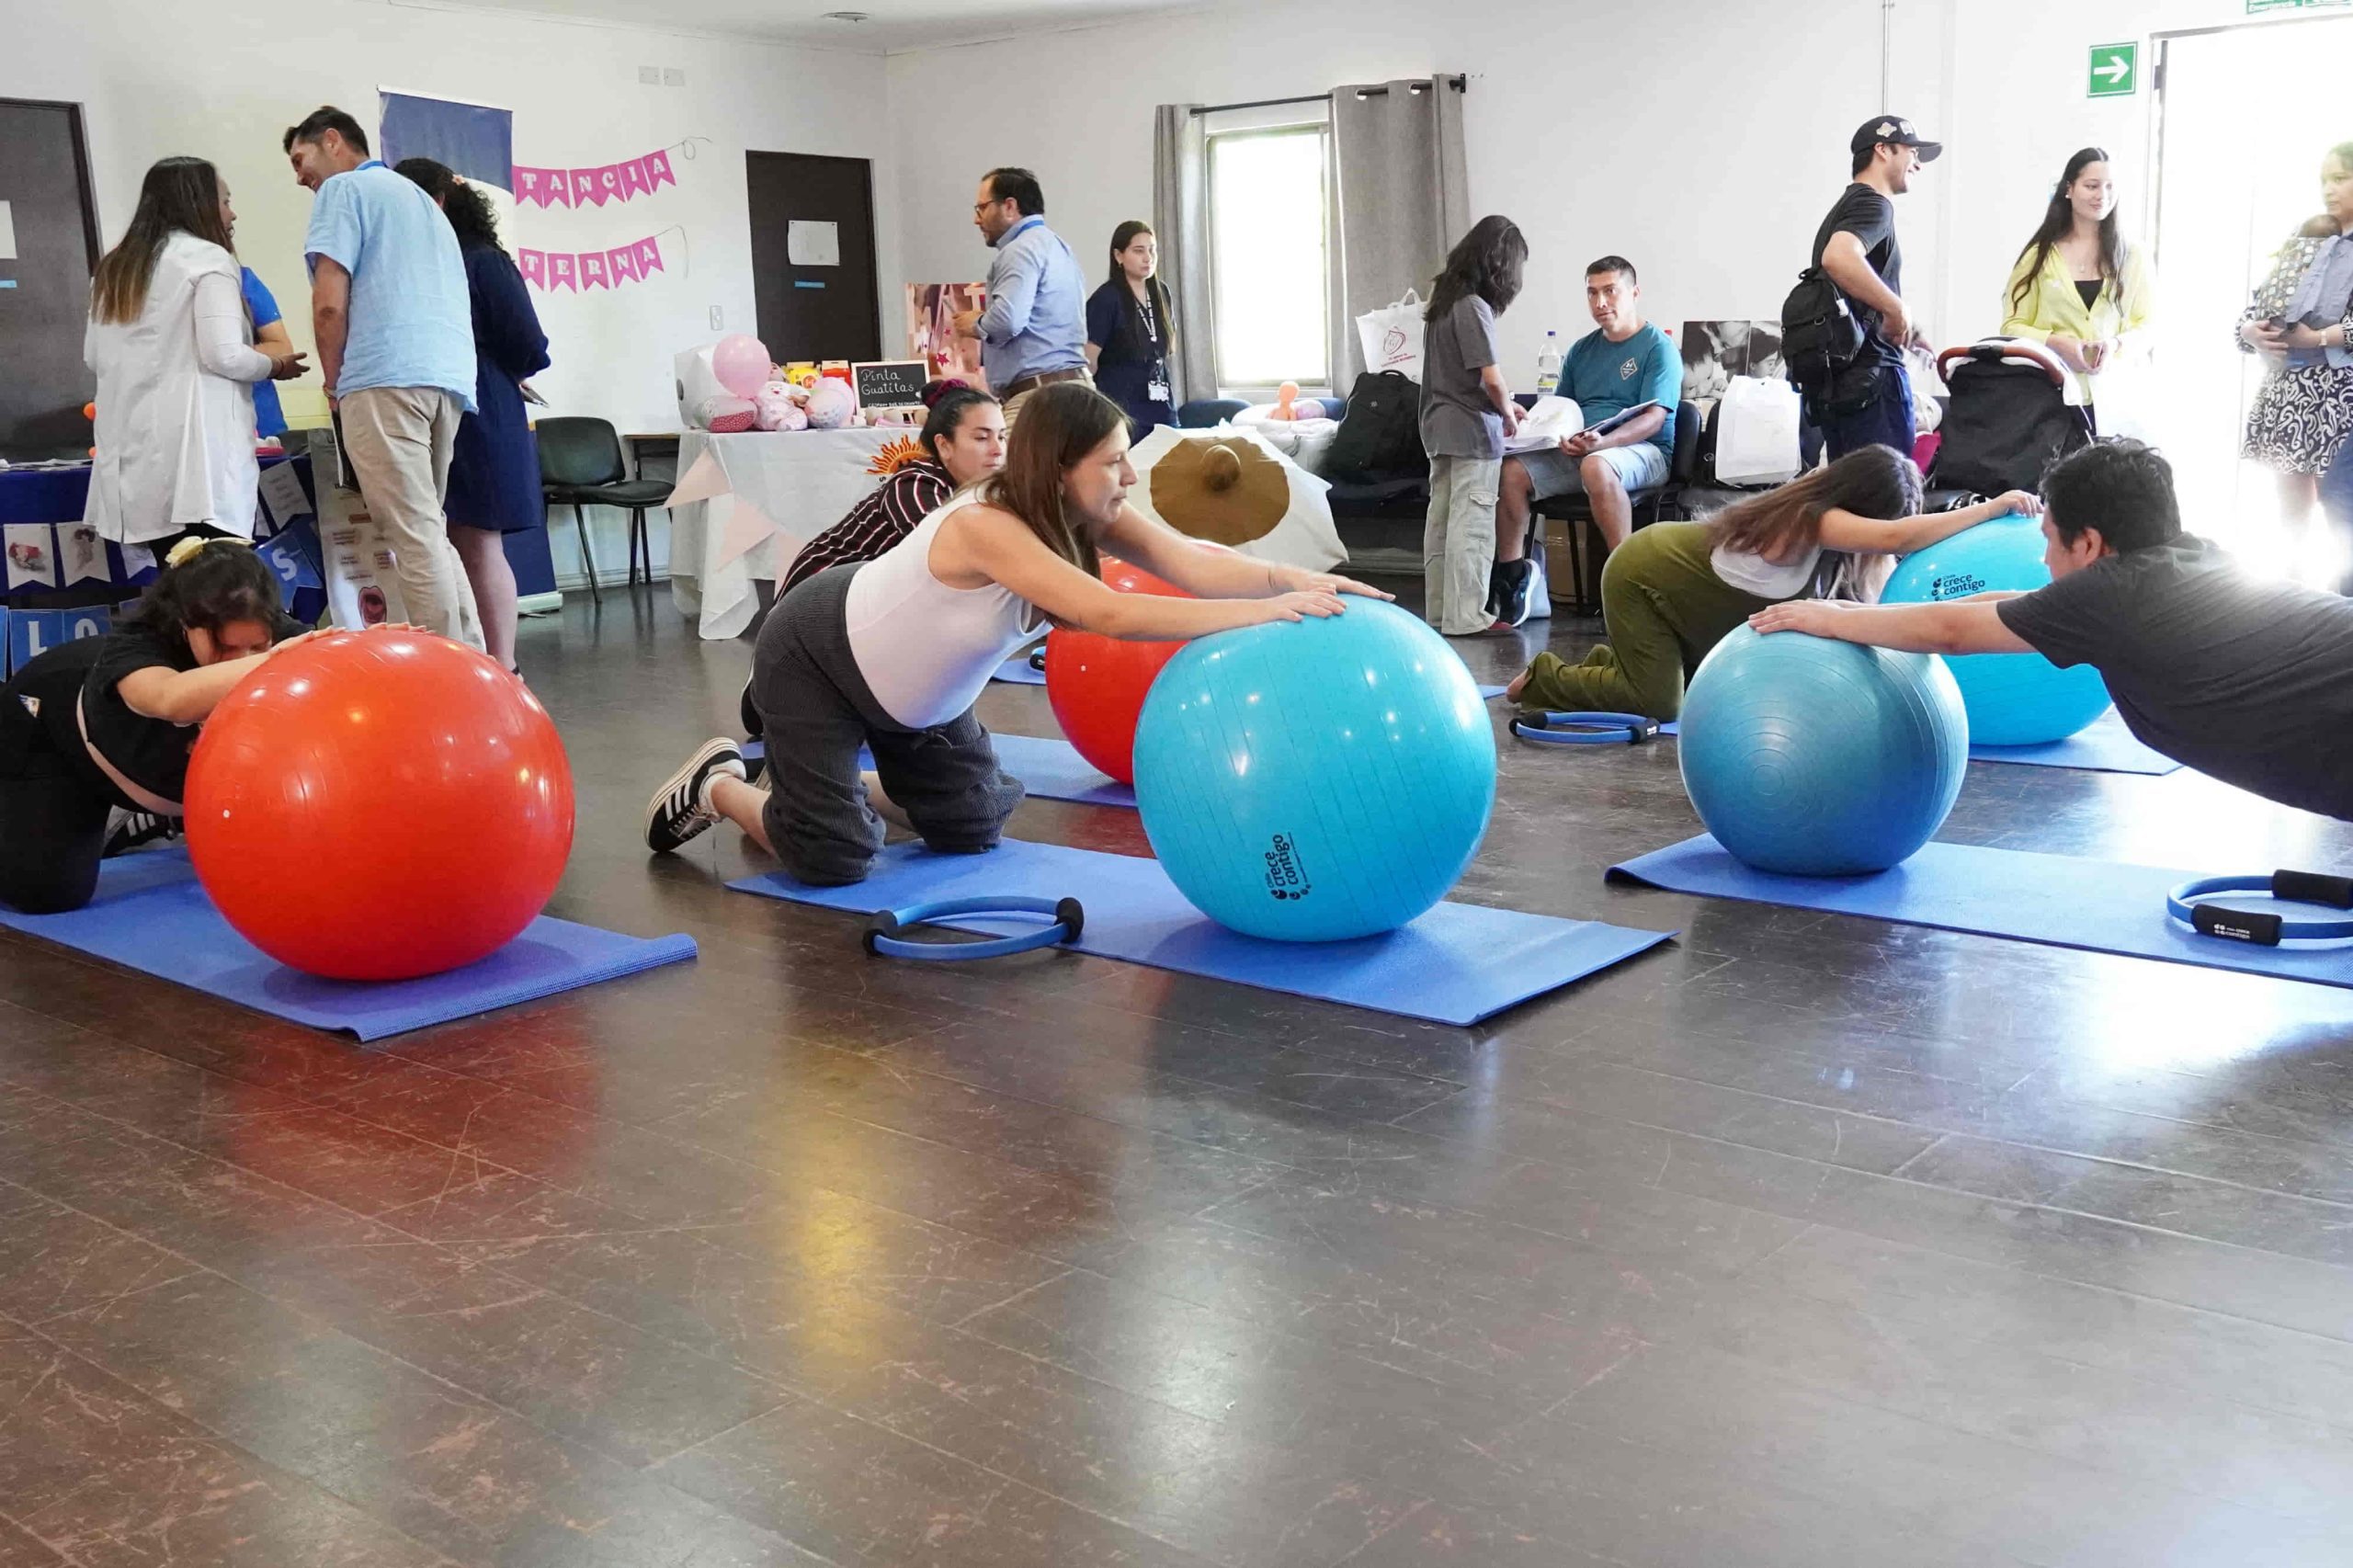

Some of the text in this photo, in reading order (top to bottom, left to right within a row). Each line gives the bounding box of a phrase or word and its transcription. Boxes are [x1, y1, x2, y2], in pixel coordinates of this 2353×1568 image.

[525, 245, 655, 276] TERNA
[1943, 574, 1972, 587] crece
[1944, 580, 1985, 596] contigo
[1265, 851, 1286, 887] crece
[1273, 835, 1299, 885] contigo
